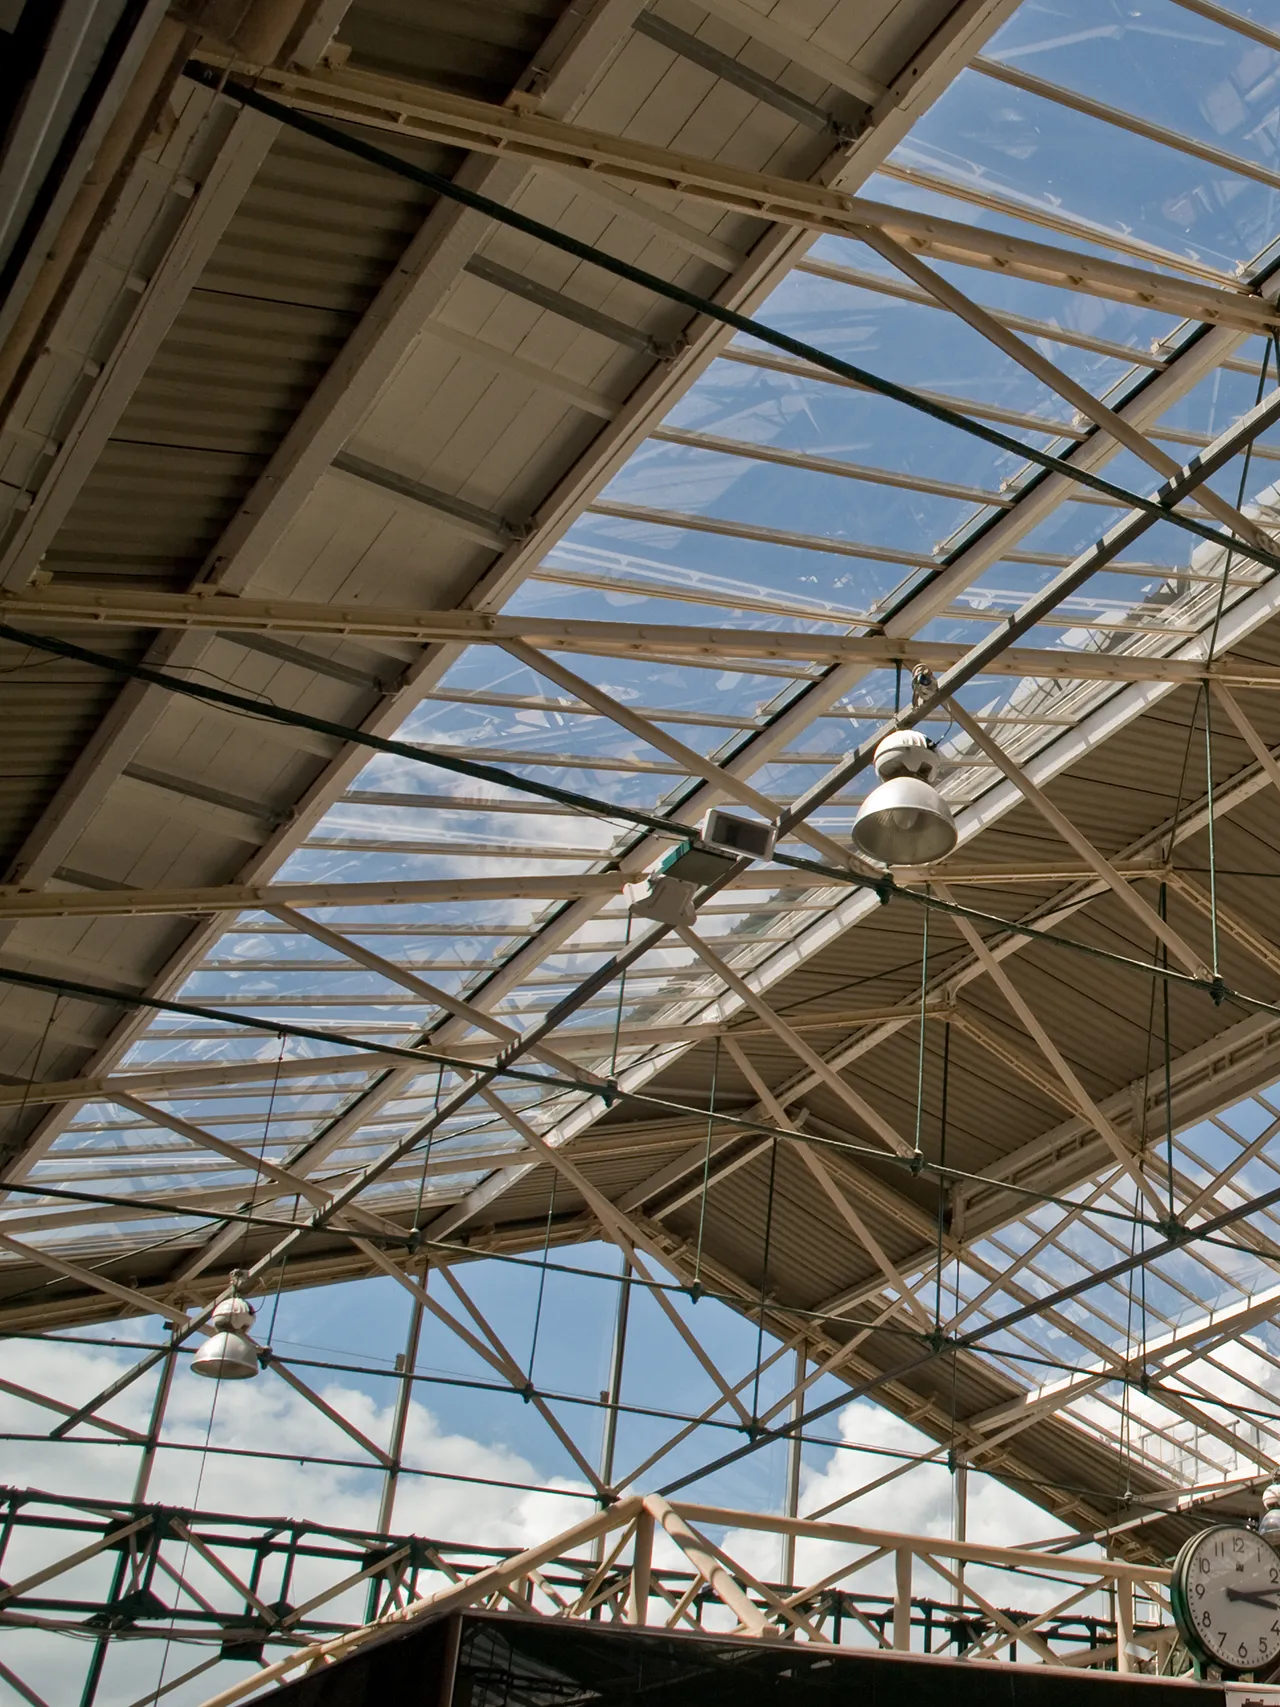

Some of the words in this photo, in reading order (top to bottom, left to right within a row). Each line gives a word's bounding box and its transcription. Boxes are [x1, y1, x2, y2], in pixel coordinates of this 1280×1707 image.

[1215, 1542, 1224, 1557] 11
[1233, 1537, 1245, 1553] 12
[1257, 1547, 1261, 1563] 1
[1199, 1558, 1210, 1574] 10
[1269, 1568, 1279, 1584] 2
[1195, 1583, 1205, 1599] 9
[1202, 1611, 1212, 1628] 8
[1270, 1620, 1280, 1636] 4
[1218, 1632, 1227, 1648] 7
[1259, 1637, 1268, 1653] 5
[1238, 1642, 1248, 1658] 6
